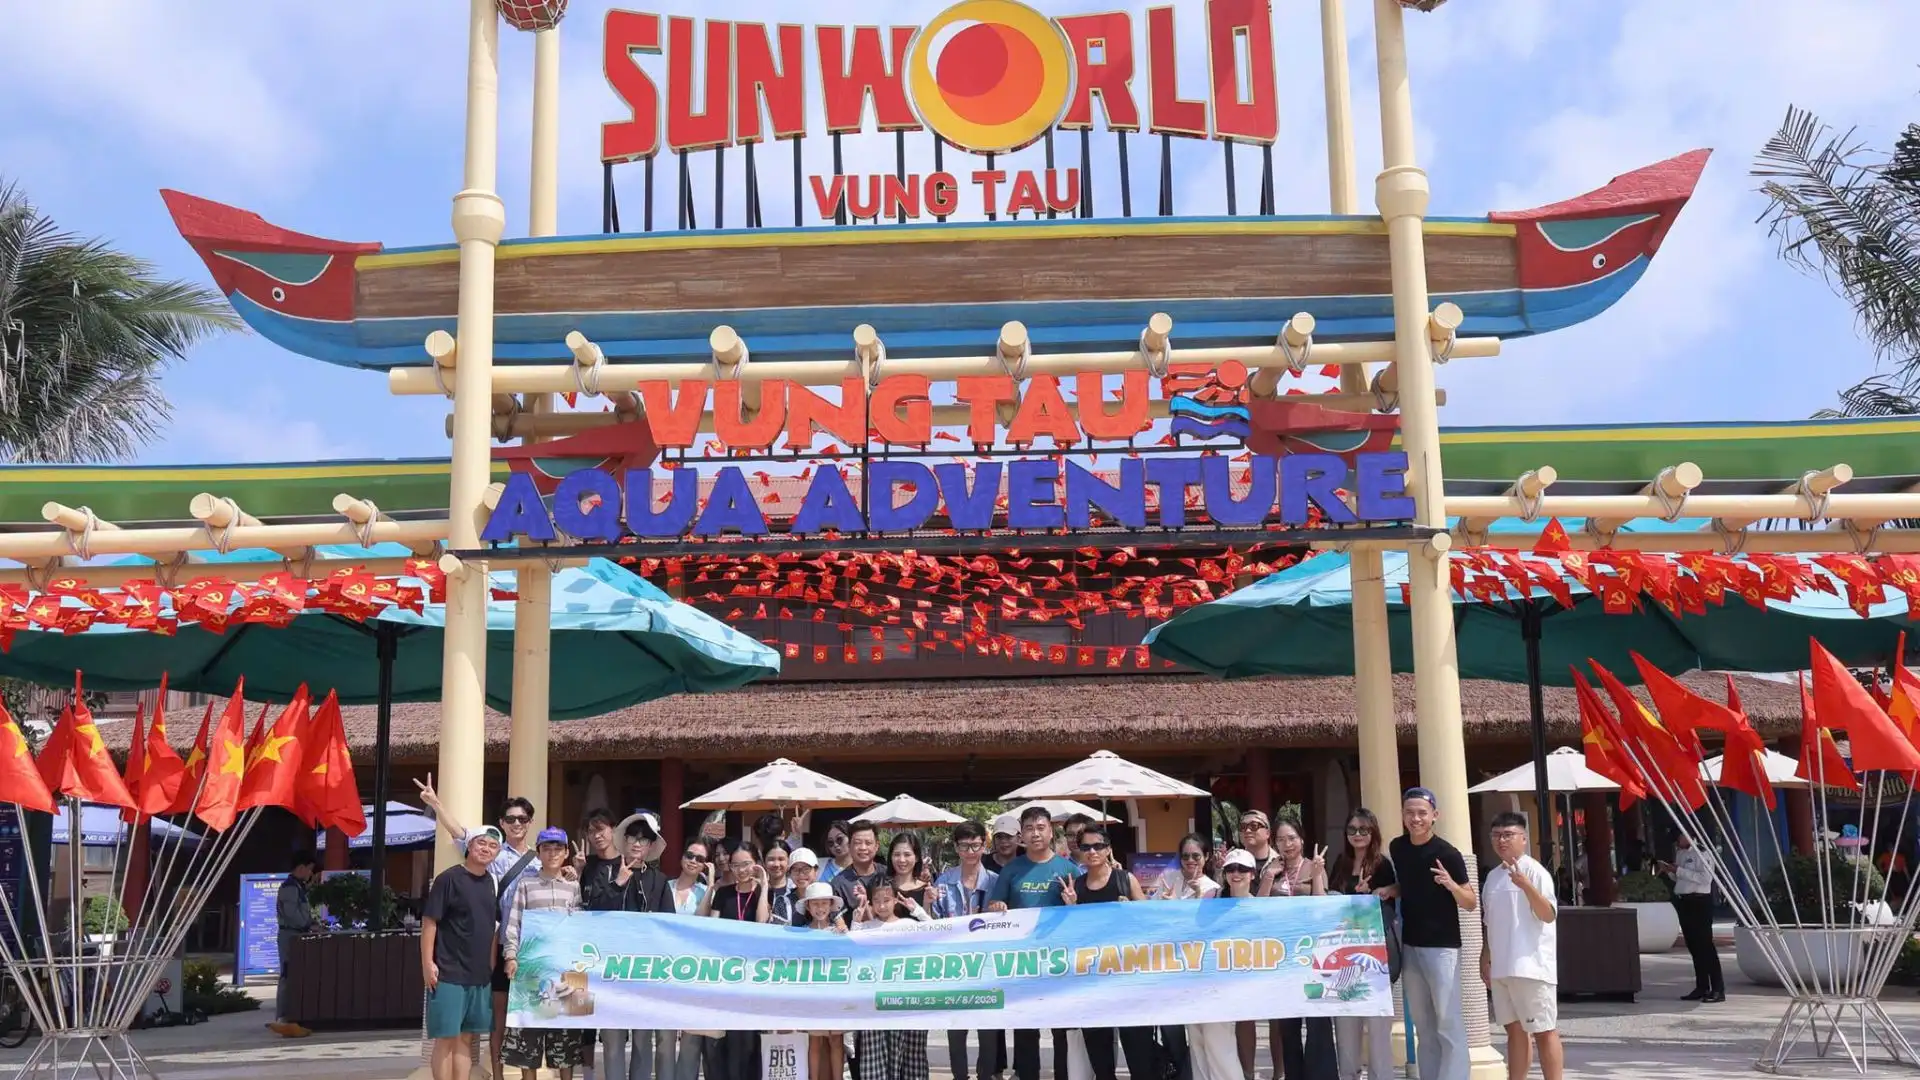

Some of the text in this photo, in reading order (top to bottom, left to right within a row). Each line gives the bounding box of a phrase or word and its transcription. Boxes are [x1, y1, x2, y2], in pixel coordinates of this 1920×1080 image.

[809, 168, 1081, 220] VUNG TAU
[637, 366, 1151, 449] VUNG TAU
[481, 450, 1417, 547] AQUA ADVENTURE
[986, 921, 1011, 930] FERRY
[602, 938, 1285, 984] MEKONG SMILE & FERRY VN'S FAMILY TRIP
[924, 996, 936, 1005] 23
[769, 1048, 796, 1067] BIG
